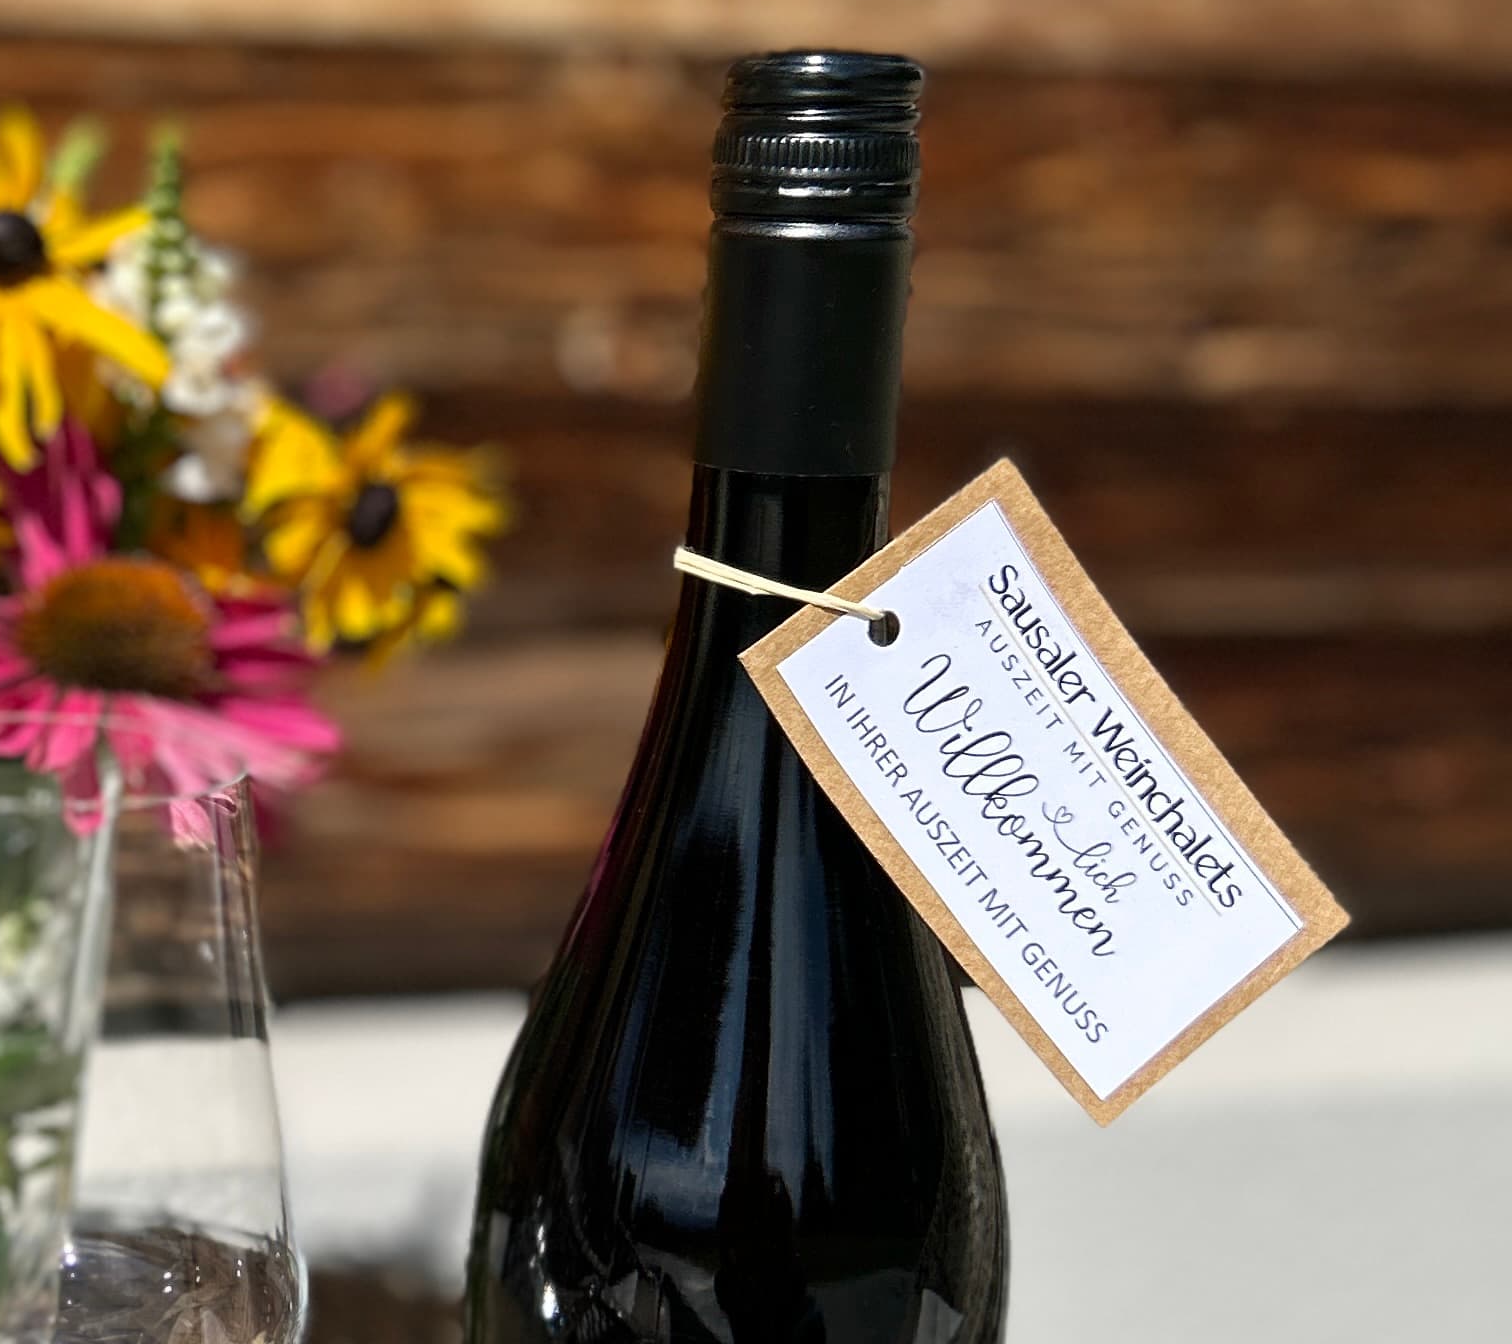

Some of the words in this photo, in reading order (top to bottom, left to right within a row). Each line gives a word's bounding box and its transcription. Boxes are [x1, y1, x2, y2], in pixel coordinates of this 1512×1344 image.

[822, 674, 851, 708] IN
[845, 707, 908, 788] IHRER
[901, 789, 988, 886] AUSZEIT
[978, 888, 1027, 938] MIT
[1022, 943, 1109, 1043] GENUSS
[903, 654, 1115, 956] Willkommen
[975, 620, 1063, 729] AUSZEIT
[1063, 741, 1106, 787] MIT
[1109, 801, 1193, 906] GENUSS
[988, 565, 1094, 702] Sausaler
[1095, 707, 1242, 907] Weinchalets
